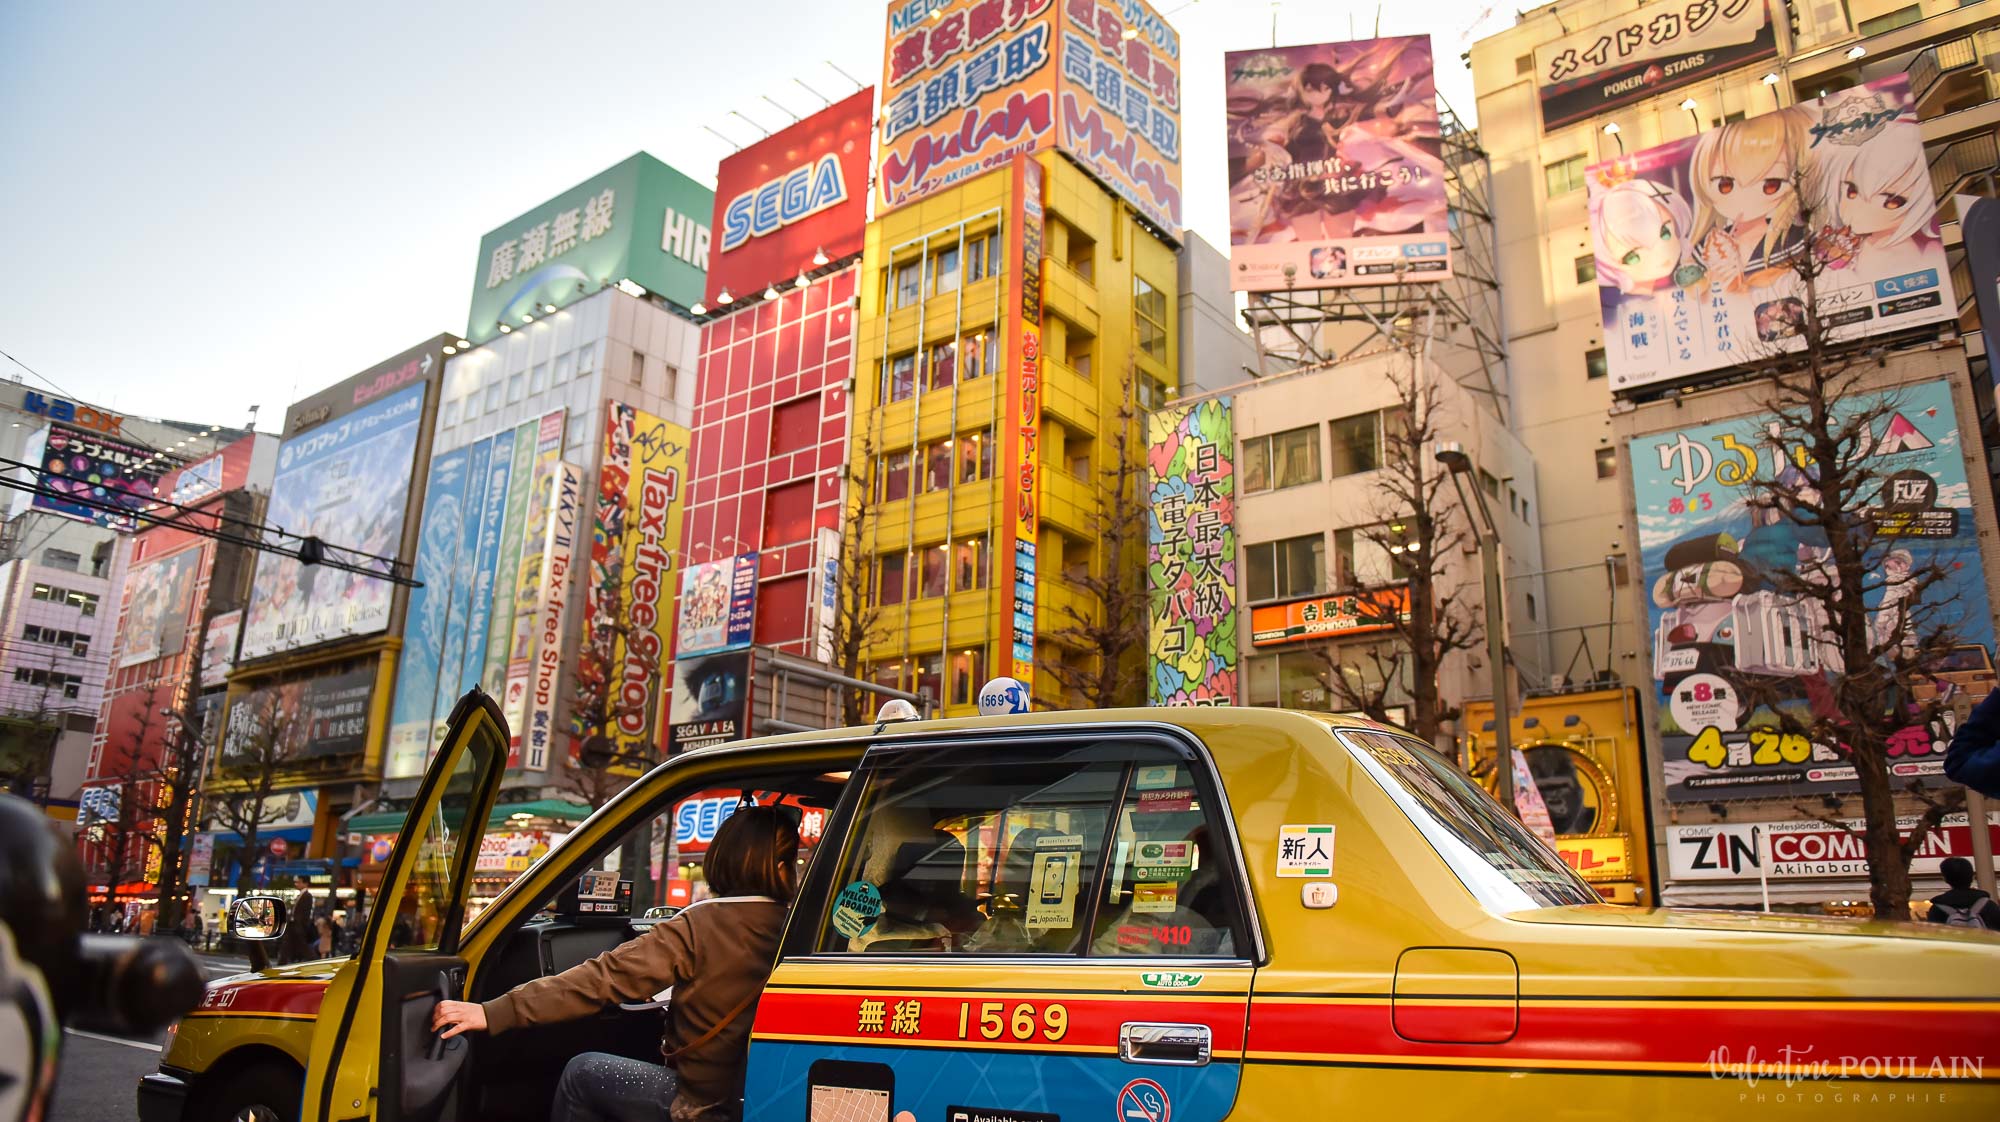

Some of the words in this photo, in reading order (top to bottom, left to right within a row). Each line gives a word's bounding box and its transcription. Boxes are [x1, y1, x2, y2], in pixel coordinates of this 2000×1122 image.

[1549, 0, 1750, 80] メイドカジノ
[886, 22, 1048, 140] 高額買取
[1064, 32, 1177, 154] 高額買取
[1603, 75, 1643, 98] POKER
[1664, 54, 1705, 77] STARS
[882, 92, 1051, 204] Mulan
[1062, 94, 1183, 226] Mulan
[722, 153, 847, 253] SEGA
[295, 422, 352, 459] ソフマップ
[558, 467, 578, 534] AKKY
[1893, 479, 1928, 502] FUZ
[629, 466, 678, 629] Tax-free
[1194, 443, 1224, 617] 日本最大級
[1161, 495, 1188, 654] 電子タバコ
[544, 553, 570, 645] Tax-free
[535, 650, 558, 705] Shop
[981, 693, 1004, 708] 1569
[676, 724, 699, 738] SEGA
[1281, 837, 1329, 860] 新人
[1678, 825, 1761, 875] ZIN
[1679, 827, 1714, 837] COMIC
[1768, 821, 1820, 832] Professional
[1774, 829, 1866, 861] COMI
[839, 898, 878, 917] ABOARD!
[841, 889, 881, 907] WELCOME
[1038, 914, 1070, 925] JapanTaxi
[857, 998, 922, 1035] 無線
[957, 1001, 1069, 1041] 1569
